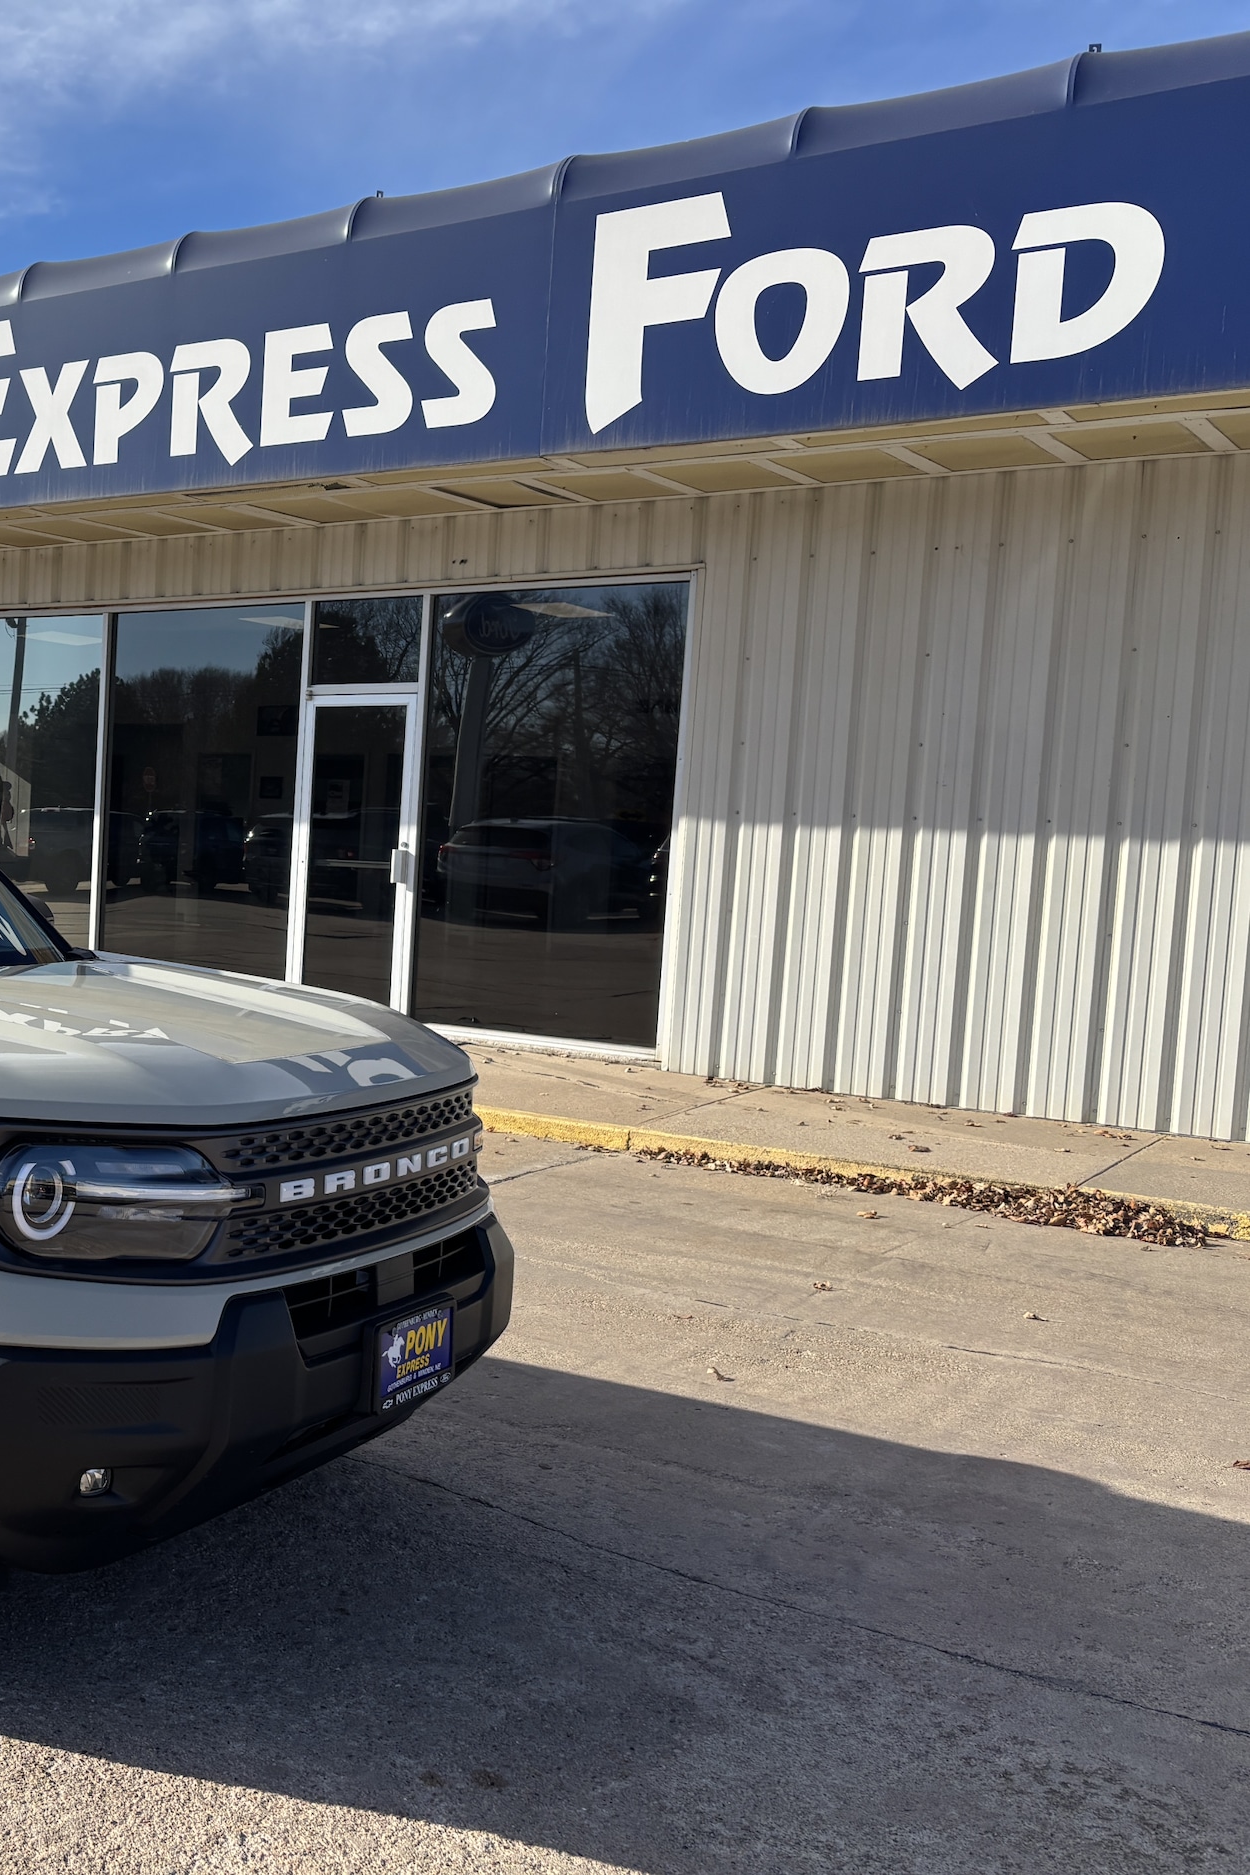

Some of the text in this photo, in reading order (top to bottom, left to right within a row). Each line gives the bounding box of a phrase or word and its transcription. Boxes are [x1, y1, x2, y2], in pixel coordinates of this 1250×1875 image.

[278, 1139, 471, 1203] BRONCO
[405, 1317, 448, 1360] PONY
[396, 1353, 430, 1379] EXPRESS
[395, 1376, 438, 1405] PONY EXPRESS
